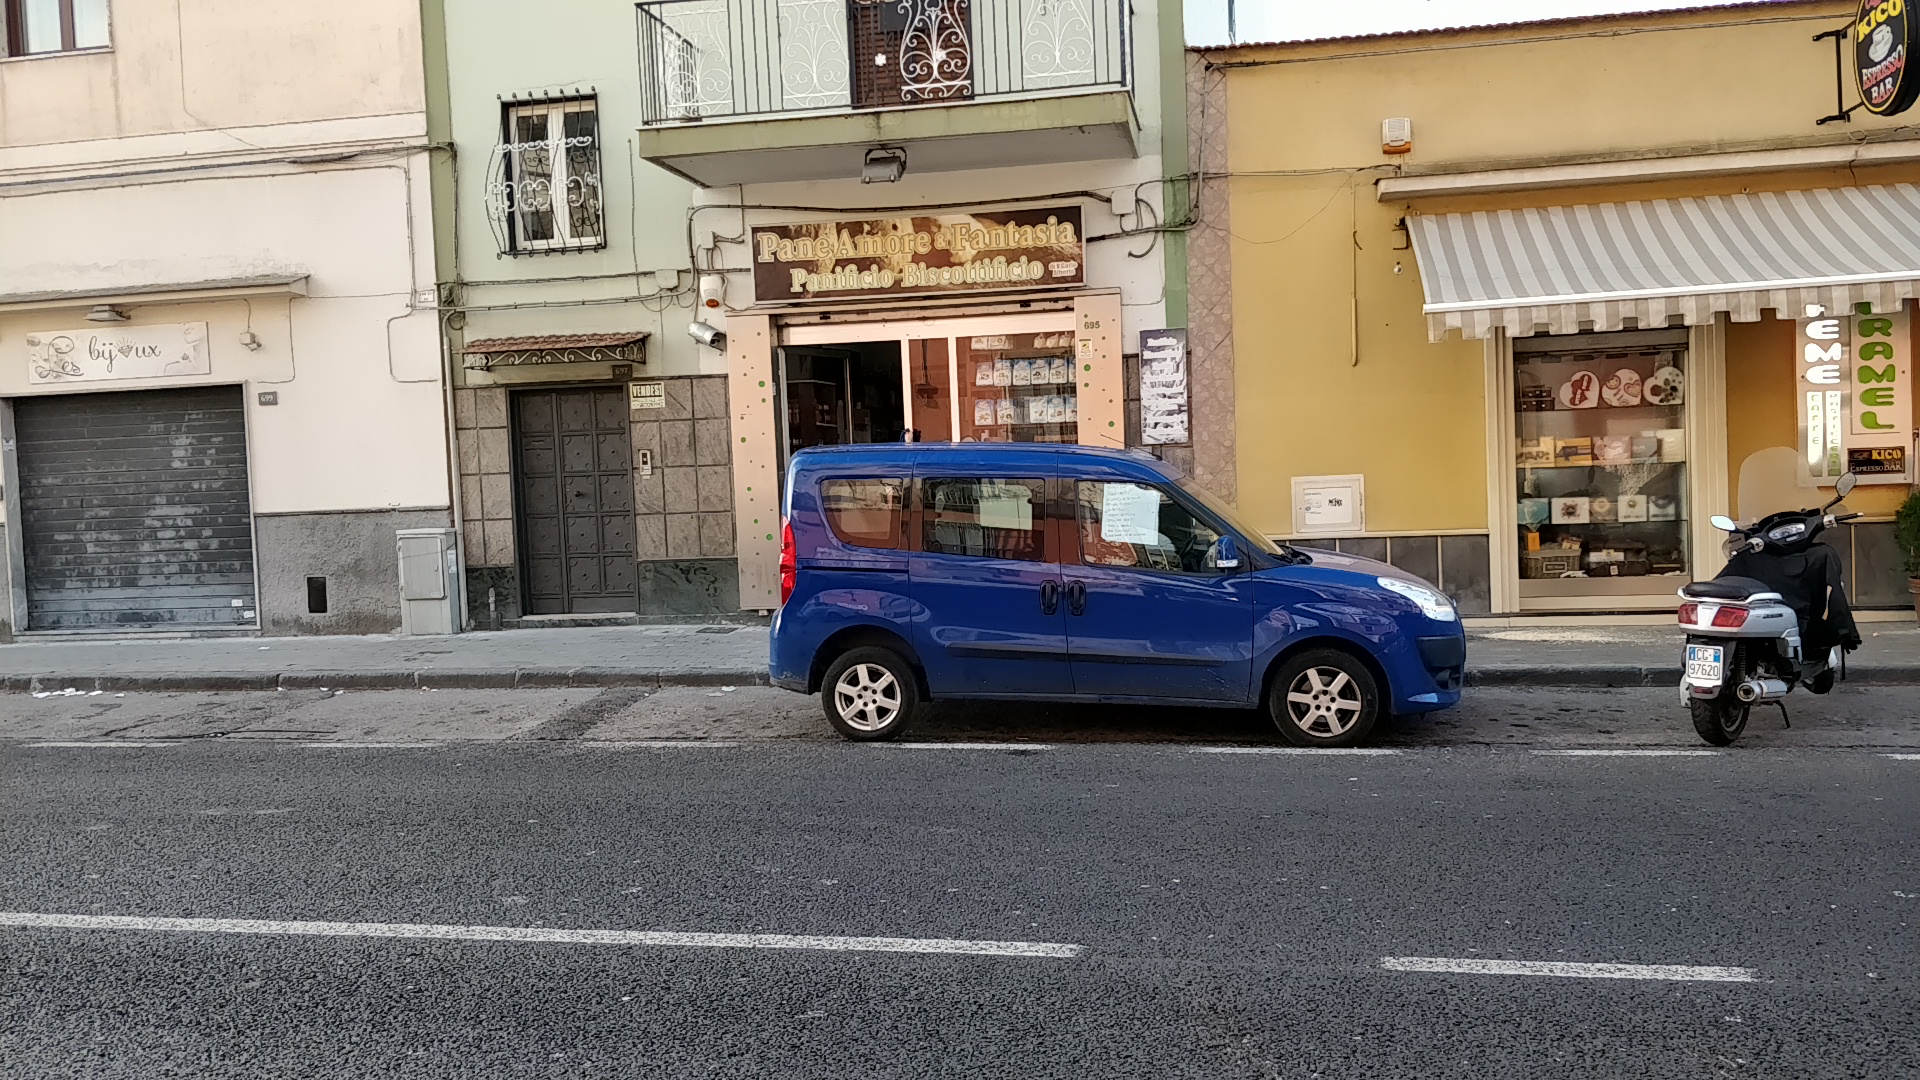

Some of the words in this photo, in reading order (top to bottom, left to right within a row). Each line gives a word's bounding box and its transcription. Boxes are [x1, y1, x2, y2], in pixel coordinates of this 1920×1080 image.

[1857, 0, 1902, 42] KICO
[1862, 44, 1904, 90] ESPRESSO
[1871, 77, 1894, 104] BAR
[757, 231, 832, 263] Pane
[833, 228, 932, 258] Amore
[934, 233, 950, 250] &
[950, 215, 1077, 252] Fantasia
[790, 263, 895, 293] Panificio
[900, 255, 1045, 288] Biscottificio
[1084, 321, 1100, 329] 695
[35, 335, 85, 379] Les
[632, 384, 662, 397] VENDESI
[1871, 449, 1902, 460] KICO
[1850, 462, 1884, 473] ESPRESSO
[1883, 460, 1902, 471] BAR
[1696, 649, 1709, 660] CG
[1690, 663, 1719, 677] 97620
